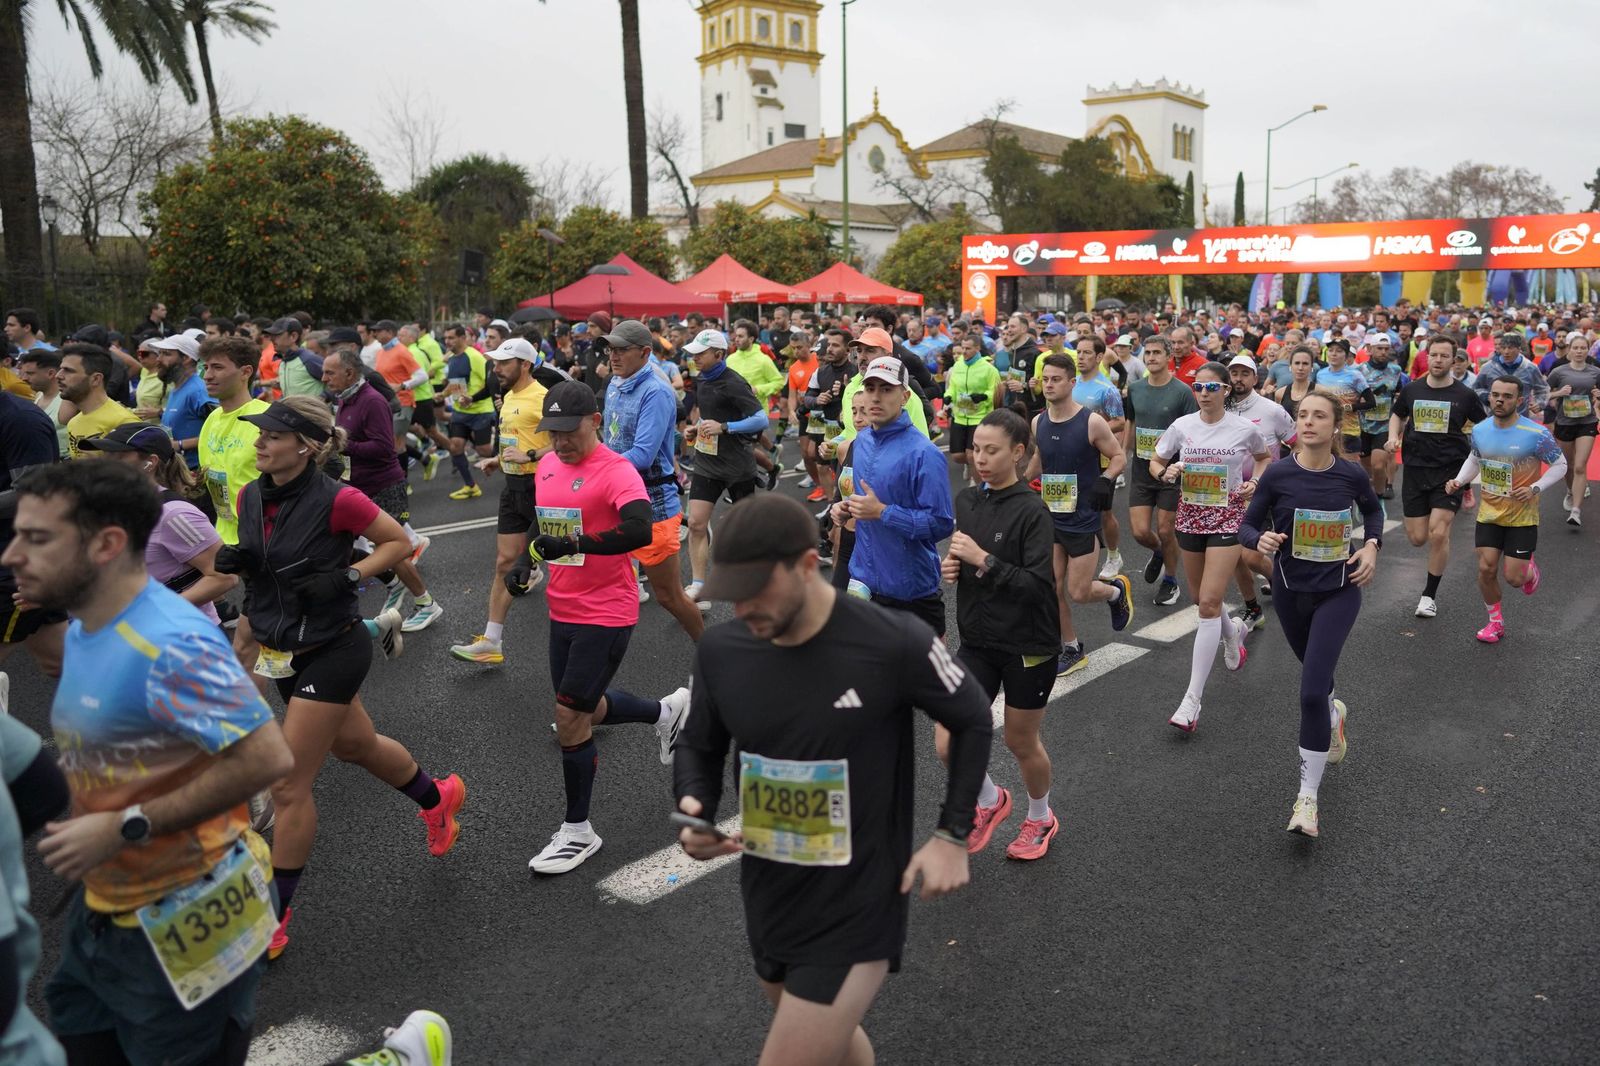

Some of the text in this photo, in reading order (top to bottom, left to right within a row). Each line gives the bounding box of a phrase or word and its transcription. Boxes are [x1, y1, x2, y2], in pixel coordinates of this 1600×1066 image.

[1373, 235, 1434, 255] HOKA
[1416, 408, 1444, 419] 10450
[1139, 435, 1157, 447] 893
[1184, 447, 1236, 456] CUATRECASAS
[1483, 464, 1507, 481] 10689
[1046, 484, 1068, 496] 8564
[542, 522, 568, 537] 9771
[1300, 522, 1345, 539] 10163
[749, 781, 829, 819] 12882
[165, 872, 257, 955] 13394
